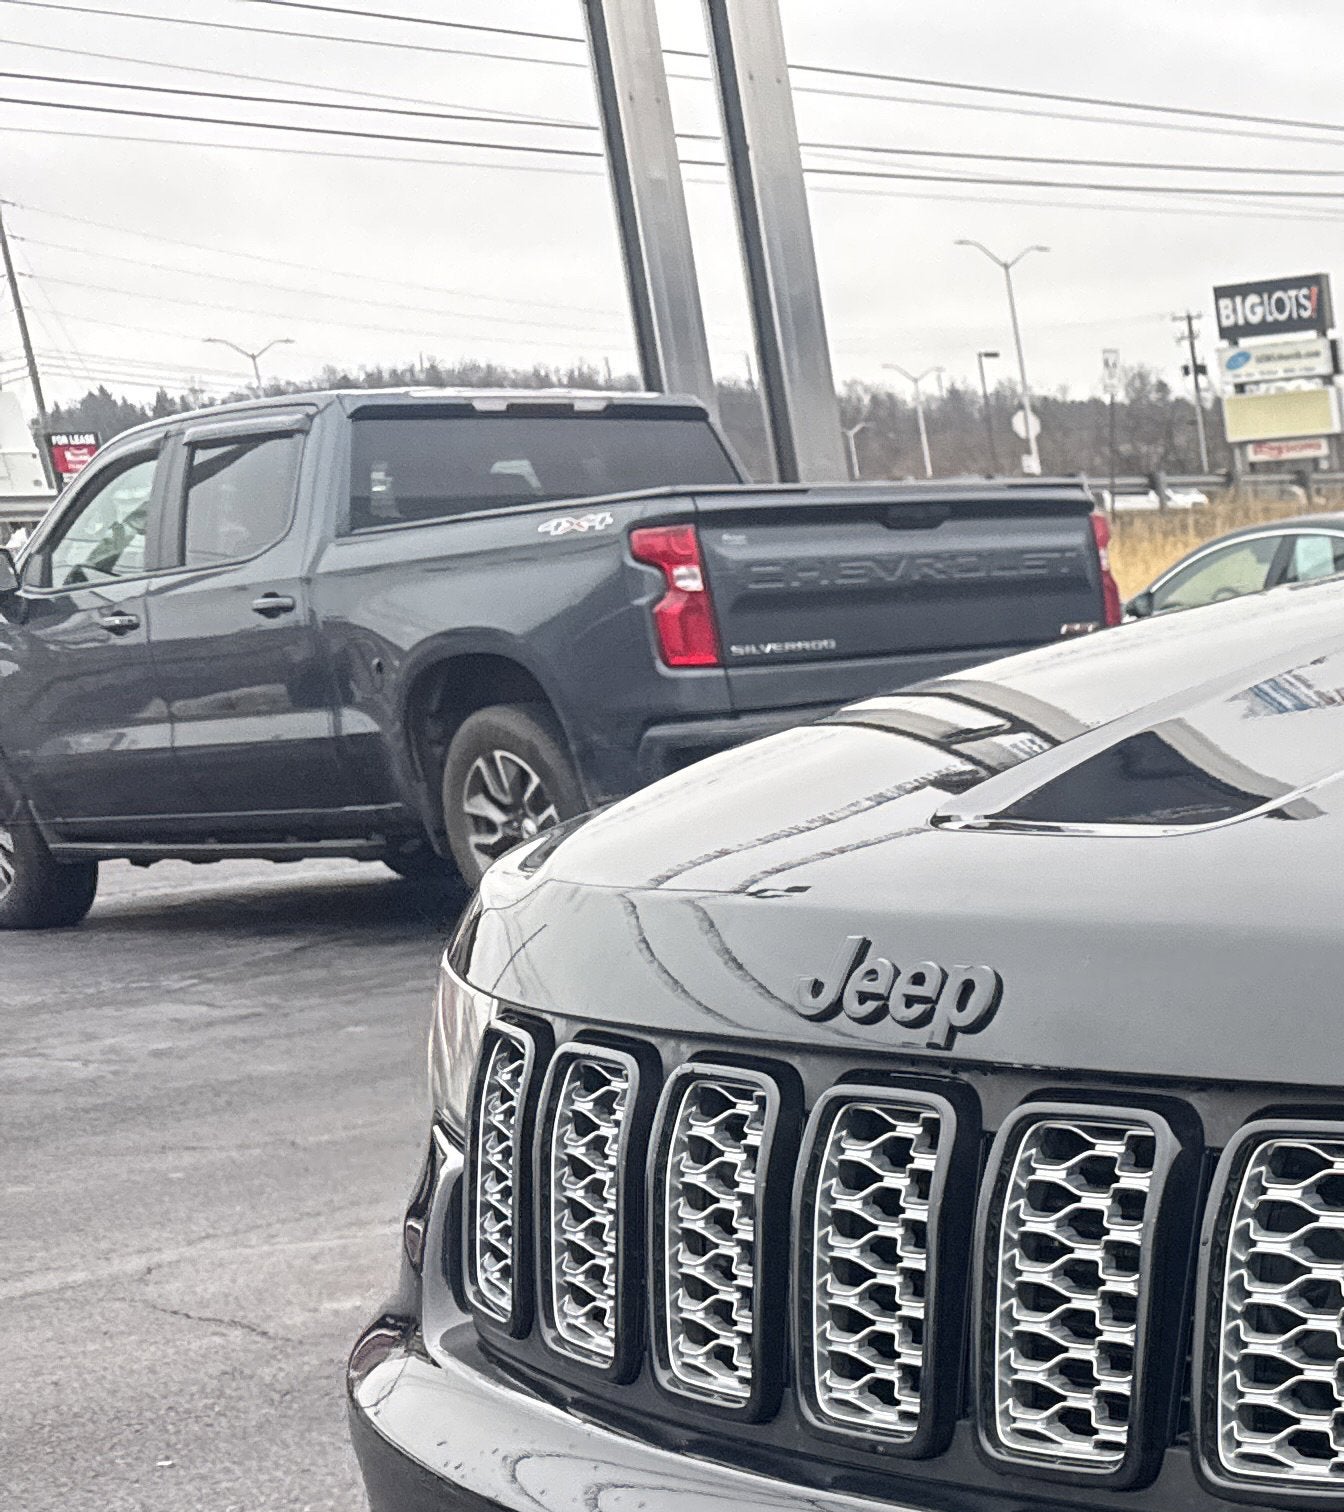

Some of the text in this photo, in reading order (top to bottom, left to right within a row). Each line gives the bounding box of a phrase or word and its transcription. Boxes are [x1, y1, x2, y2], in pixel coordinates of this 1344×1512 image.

[52, 434, 96, 445] FOR LEASE
[748, 551, 1079, 589] CHEVROLET
[730, 639, 836, 656] SILVERADO
[794, 935, 1004, 1051] Jeep
